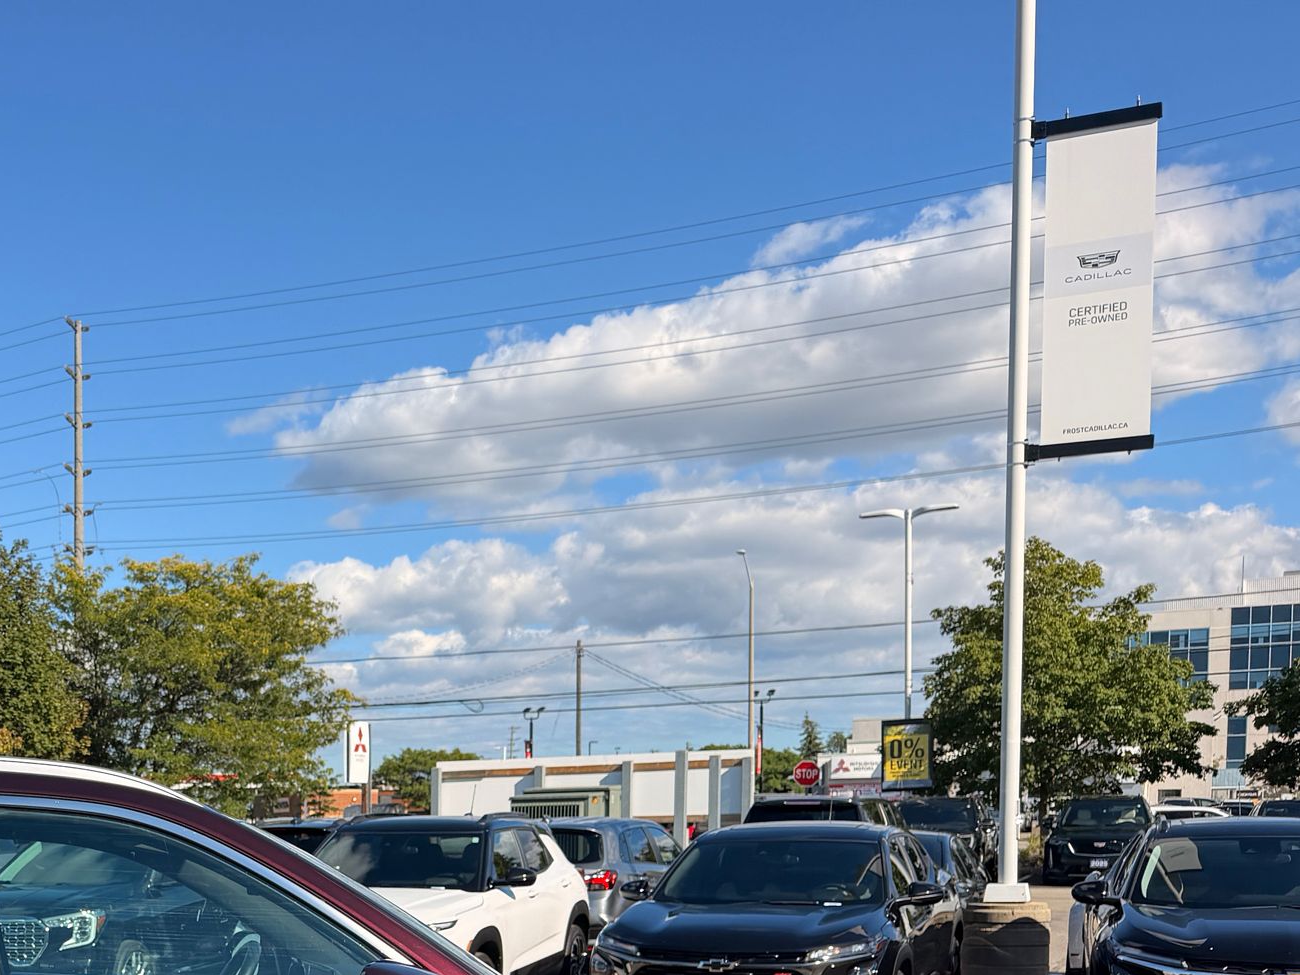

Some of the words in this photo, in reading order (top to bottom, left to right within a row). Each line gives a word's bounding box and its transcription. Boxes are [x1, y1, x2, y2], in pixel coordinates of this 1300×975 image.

[1064, 268, 1132, 284] CADILLAC
[1069, 301, 1128, 318] CERTIFIED
[1068, 311, 1128, 327] PRE-OWNED
[1062, 422, 1129, 435] FROSTCADILLAC.CA
[890, 738, 925, 760] 0%
[890, 759, 923, 771] EVENT
[795, 768, 819, 780] STOP
